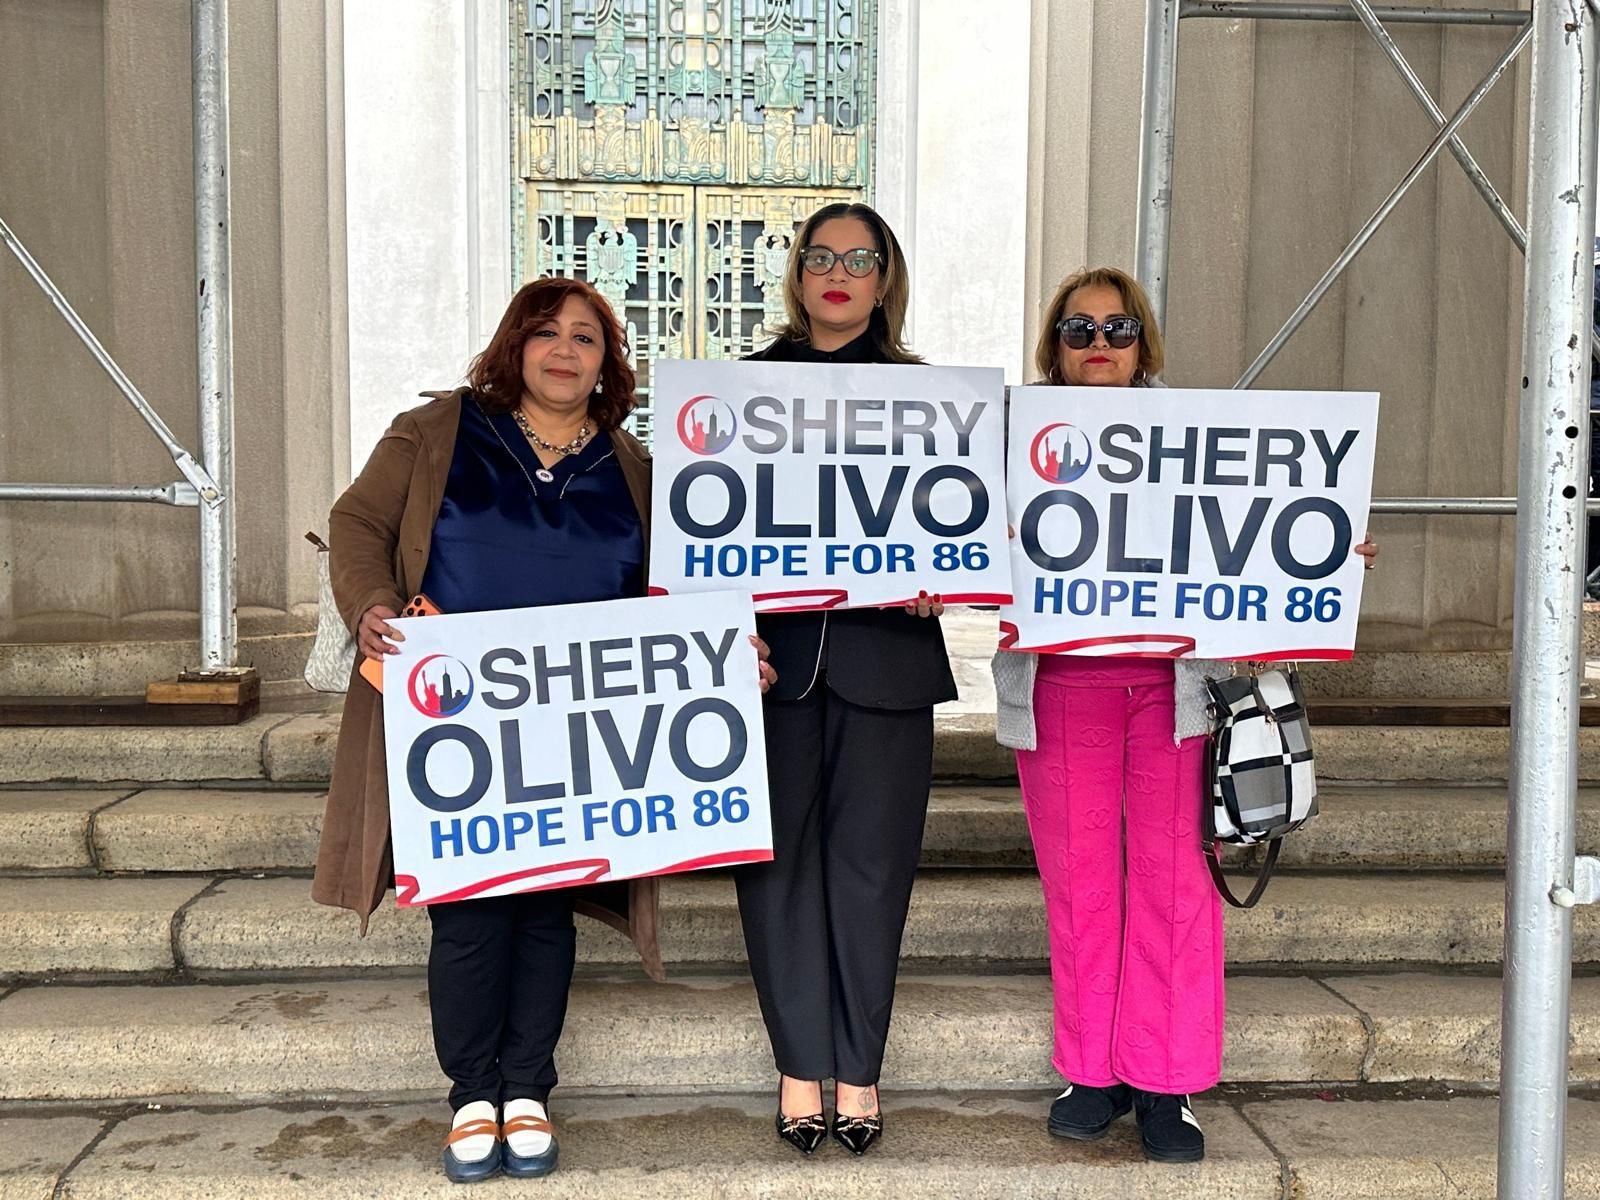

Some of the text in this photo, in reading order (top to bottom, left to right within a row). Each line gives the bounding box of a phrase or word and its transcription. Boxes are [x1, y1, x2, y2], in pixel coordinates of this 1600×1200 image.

[742, 395, 987, 456] SHERY
[1097, 423, 1360, 488] SHERY
[669, 460, 989, 538] OLIVO
[1020, 489, 1352, 580] OLIVO
[684, 541, 990, 577] HOPE FOR 86
[1034, 577, 1342, 623] HOPE FOR 86
[479, 628, 739, 710] SHERY
[406, 697, 748, 813] OLIVO
[430, 786, 750, 859] HOPE FOR 86
